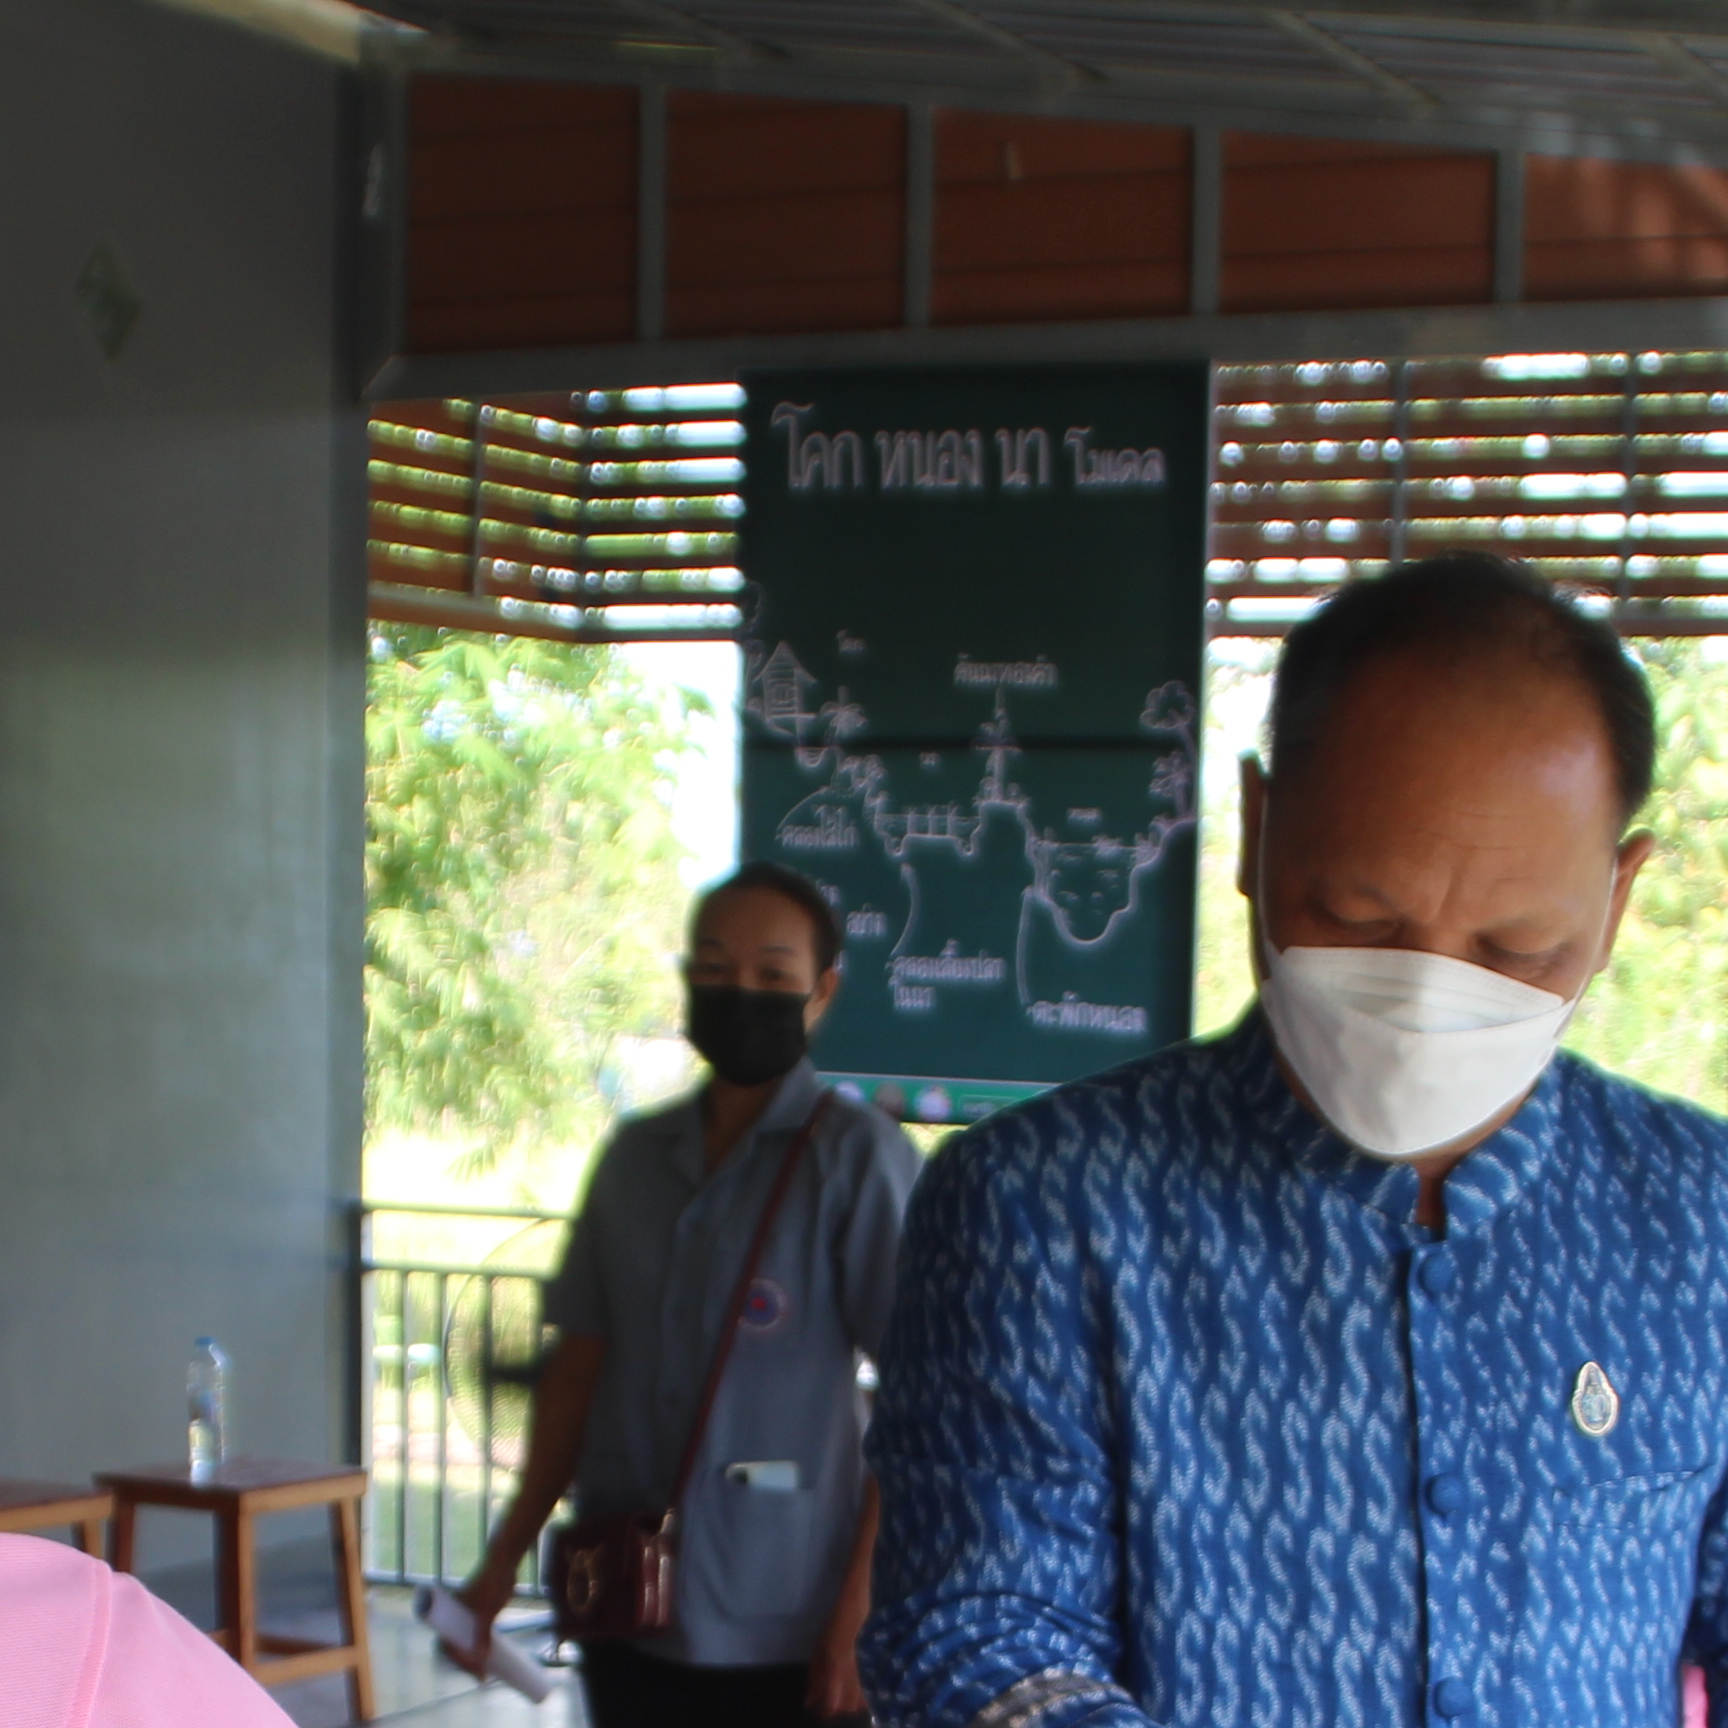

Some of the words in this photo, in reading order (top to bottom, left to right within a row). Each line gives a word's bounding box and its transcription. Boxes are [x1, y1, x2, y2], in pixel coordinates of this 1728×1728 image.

[771, 401, 864, 488] โคก
[874, 428, 983, 488] หนอง
[994, 427, 1051, 488] นา
[1064, 425, 1167, 486] โมเดล
